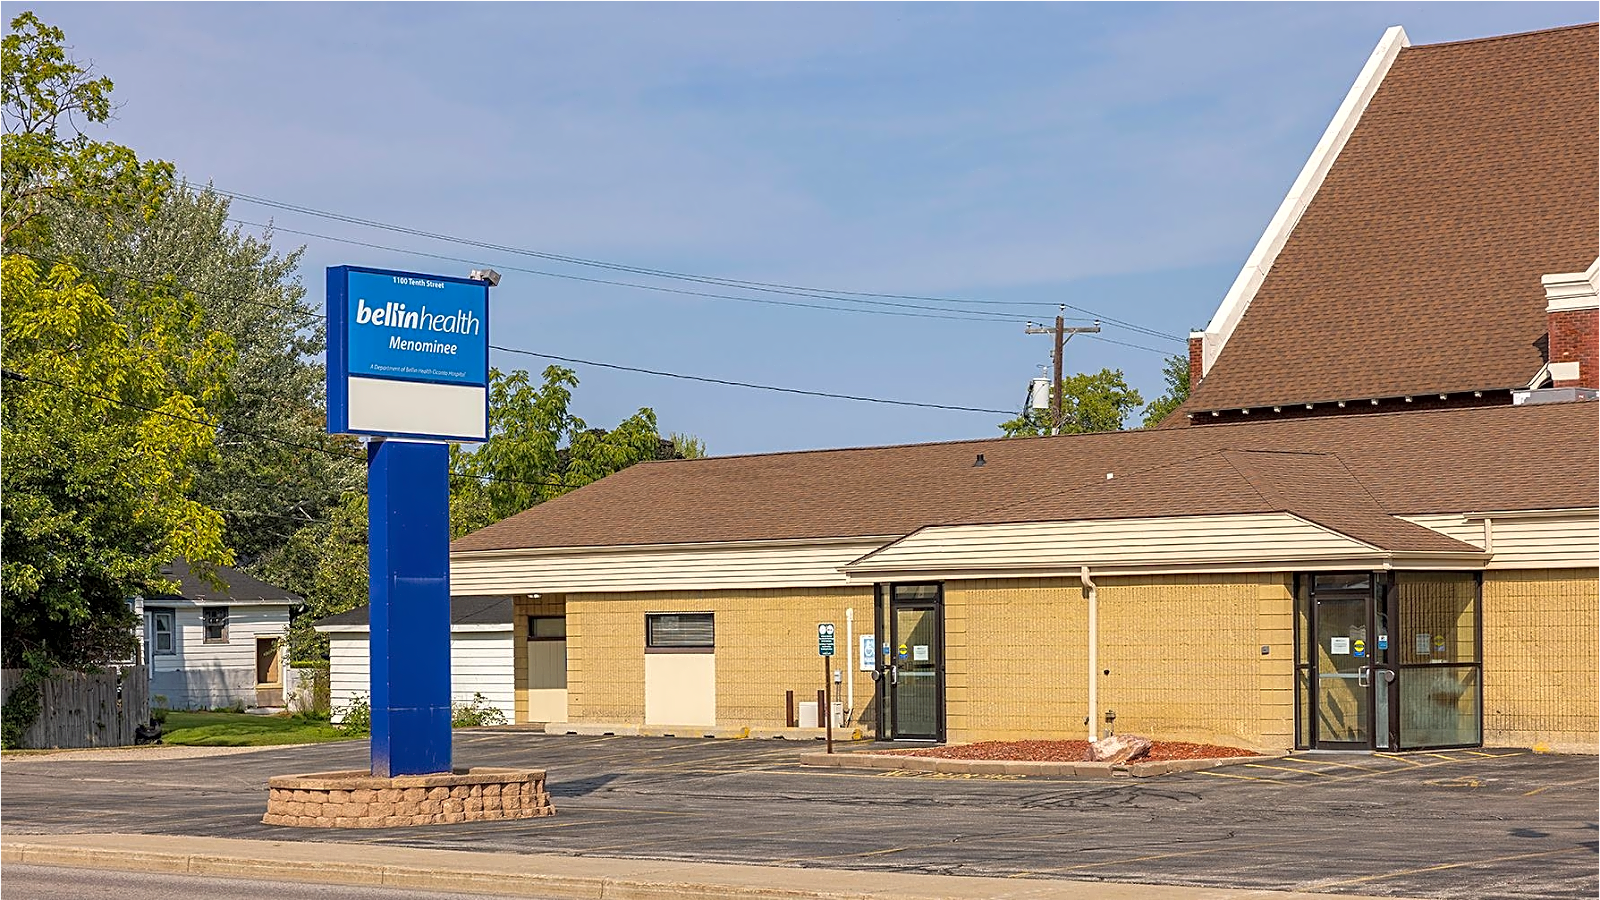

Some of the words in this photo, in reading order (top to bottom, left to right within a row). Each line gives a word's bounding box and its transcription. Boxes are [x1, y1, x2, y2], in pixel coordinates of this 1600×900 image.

[393, 276, 408, 285] 1100
[409, 278, 425, 287] Tenth
[426, 280, 445, 289] Street
[389, 336, 457, 354] Menominee
[374, 364, 400, 372] Department
[448, 370, 466, 378] Hospital
